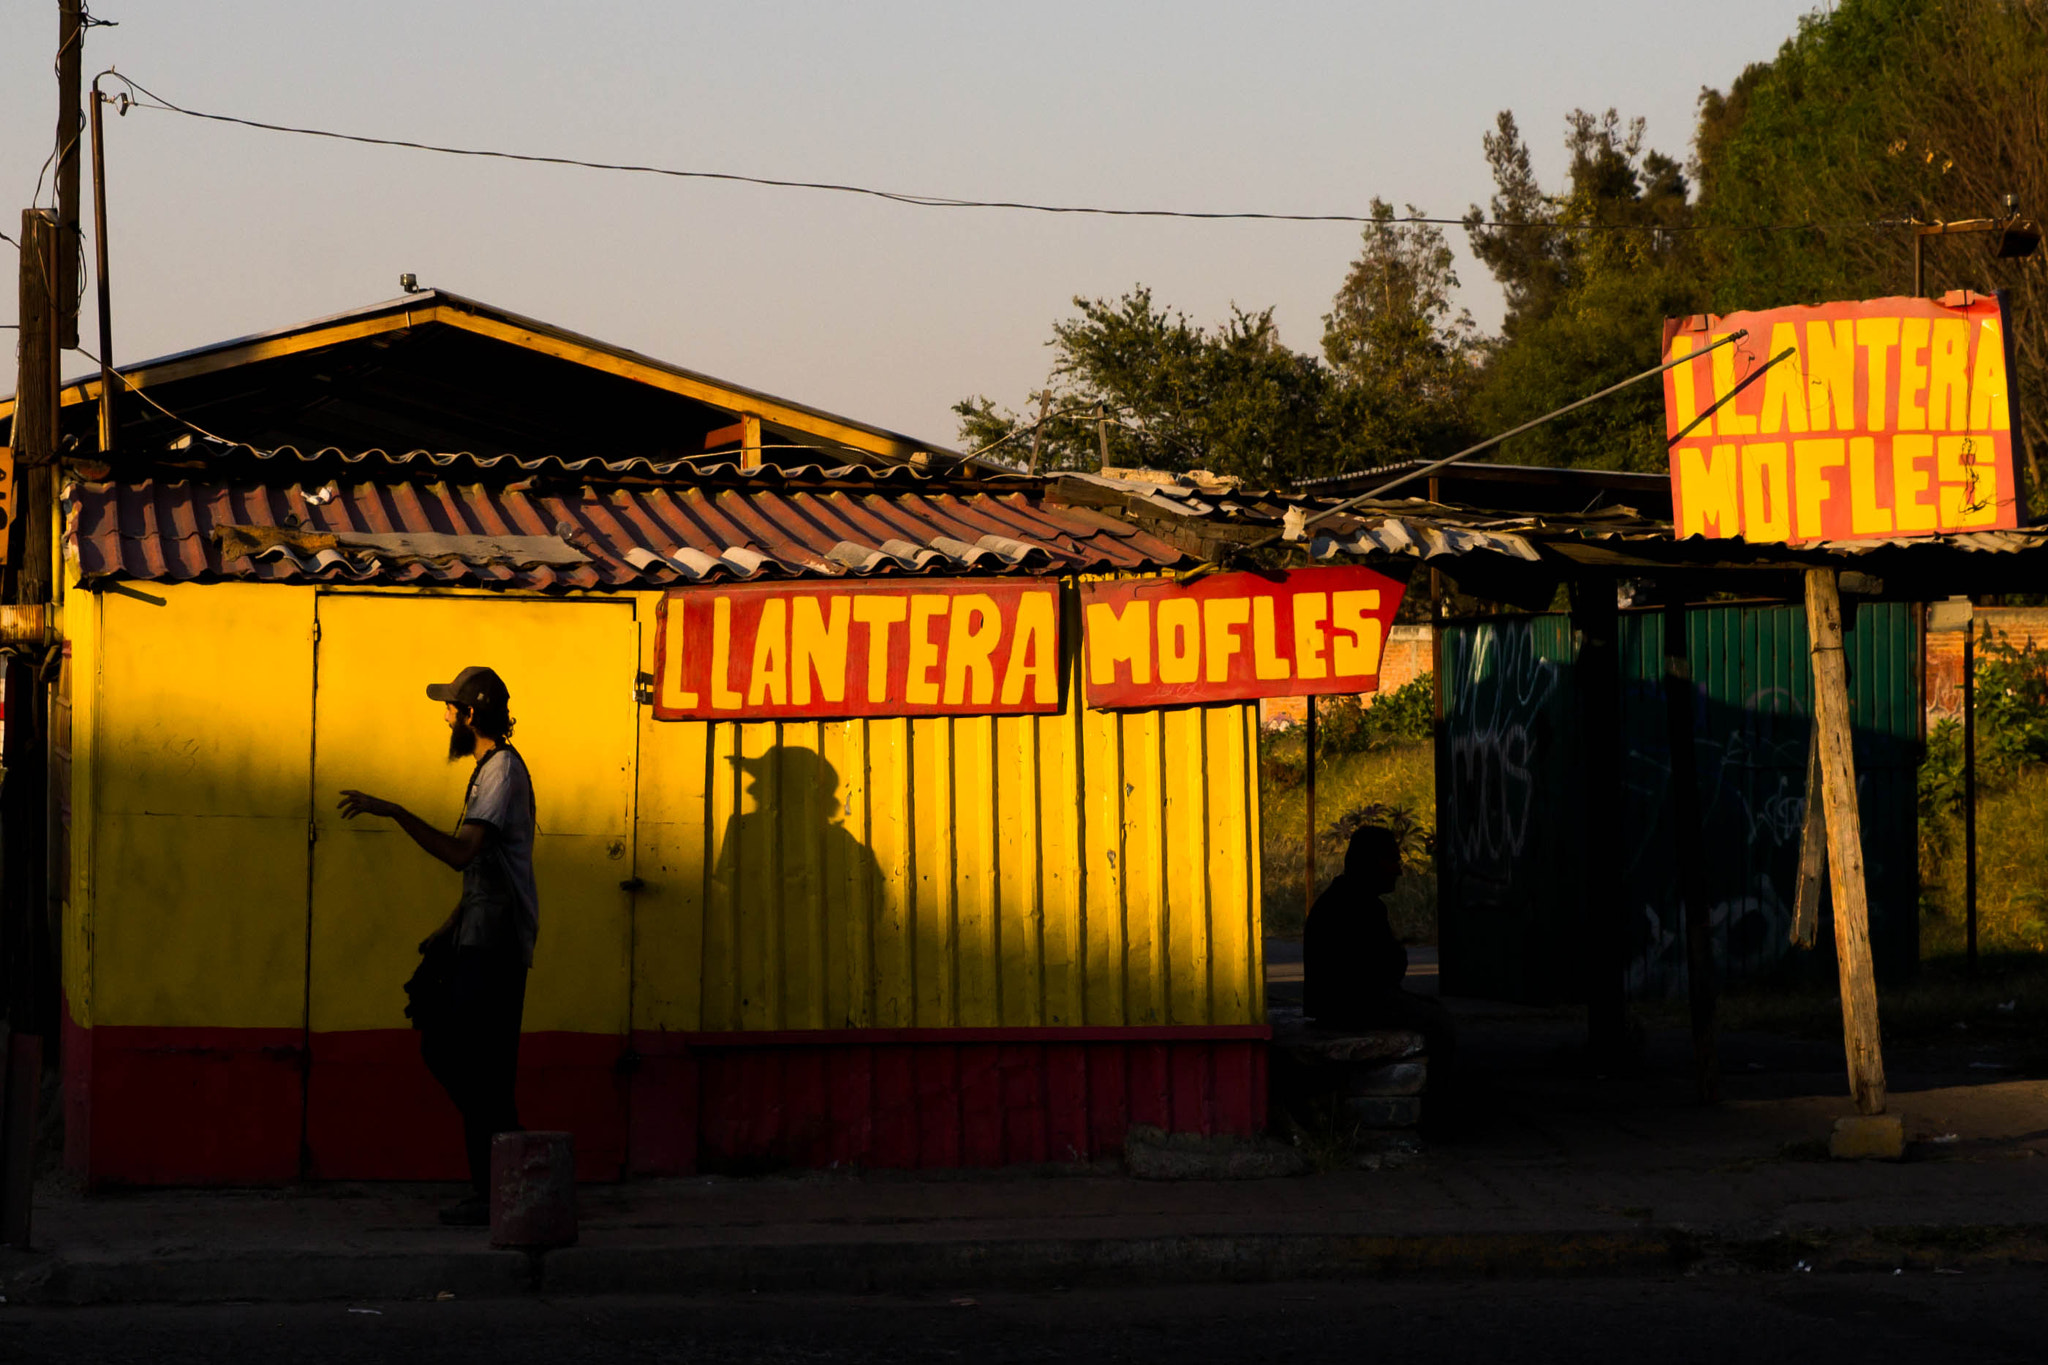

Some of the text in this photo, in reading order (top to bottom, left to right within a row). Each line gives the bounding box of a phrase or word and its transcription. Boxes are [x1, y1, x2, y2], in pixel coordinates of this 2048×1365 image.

[1670, 316, 2012, 438] LLANTERA
[1678, 433, 1998, 544] MOFLES
[663, 591, 1060, 710] LLANTERA
[1087, 588, 1383, 686] MOFLES
